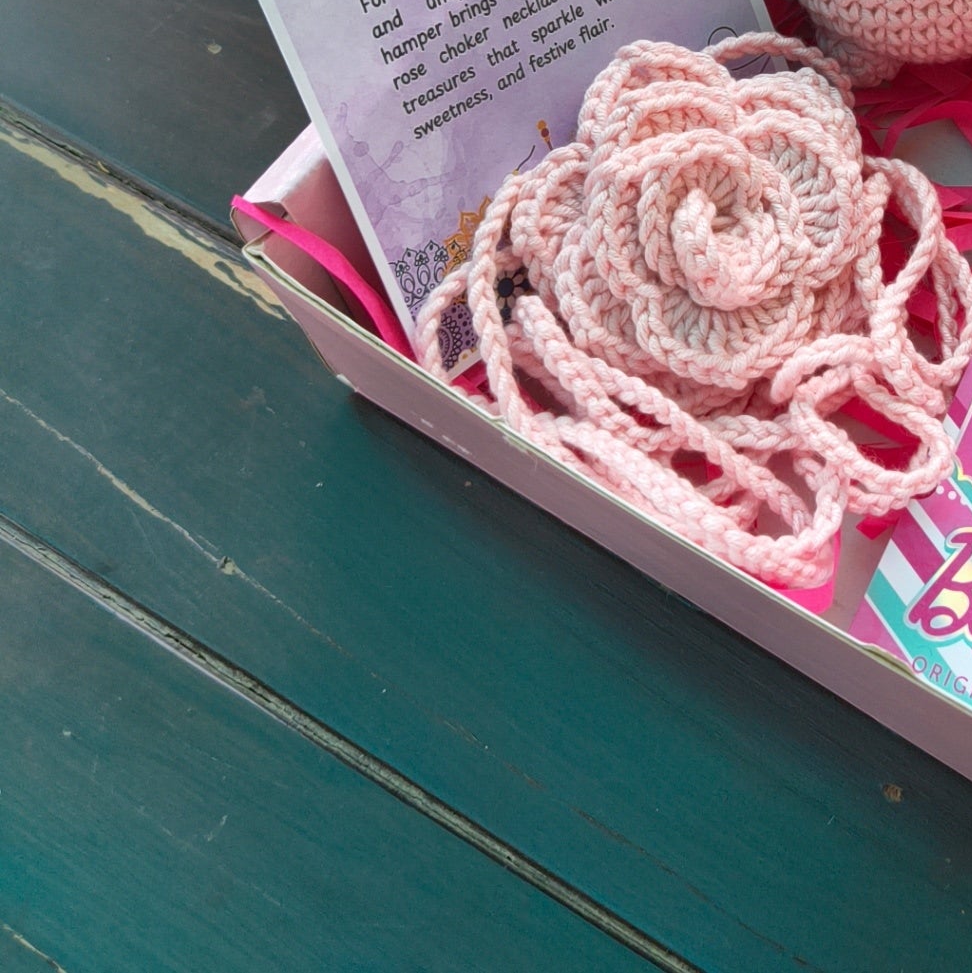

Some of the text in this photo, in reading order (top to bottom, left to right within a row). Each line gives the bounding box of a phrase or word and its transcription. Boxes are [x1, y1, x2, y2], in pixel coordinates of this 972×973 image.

[371, 9, 404, 39] and
[380, 22, 442, 65] hamper
[392, 64, 427, 90] rose
[439, 27, 490, 64] choker
[402, 66, 476, 115] treasures
[487, 40, 520, 67] that
[531, 6, 585, 43] sparkle
[413, 15, 616, 140] sweetness, and festive flair.
